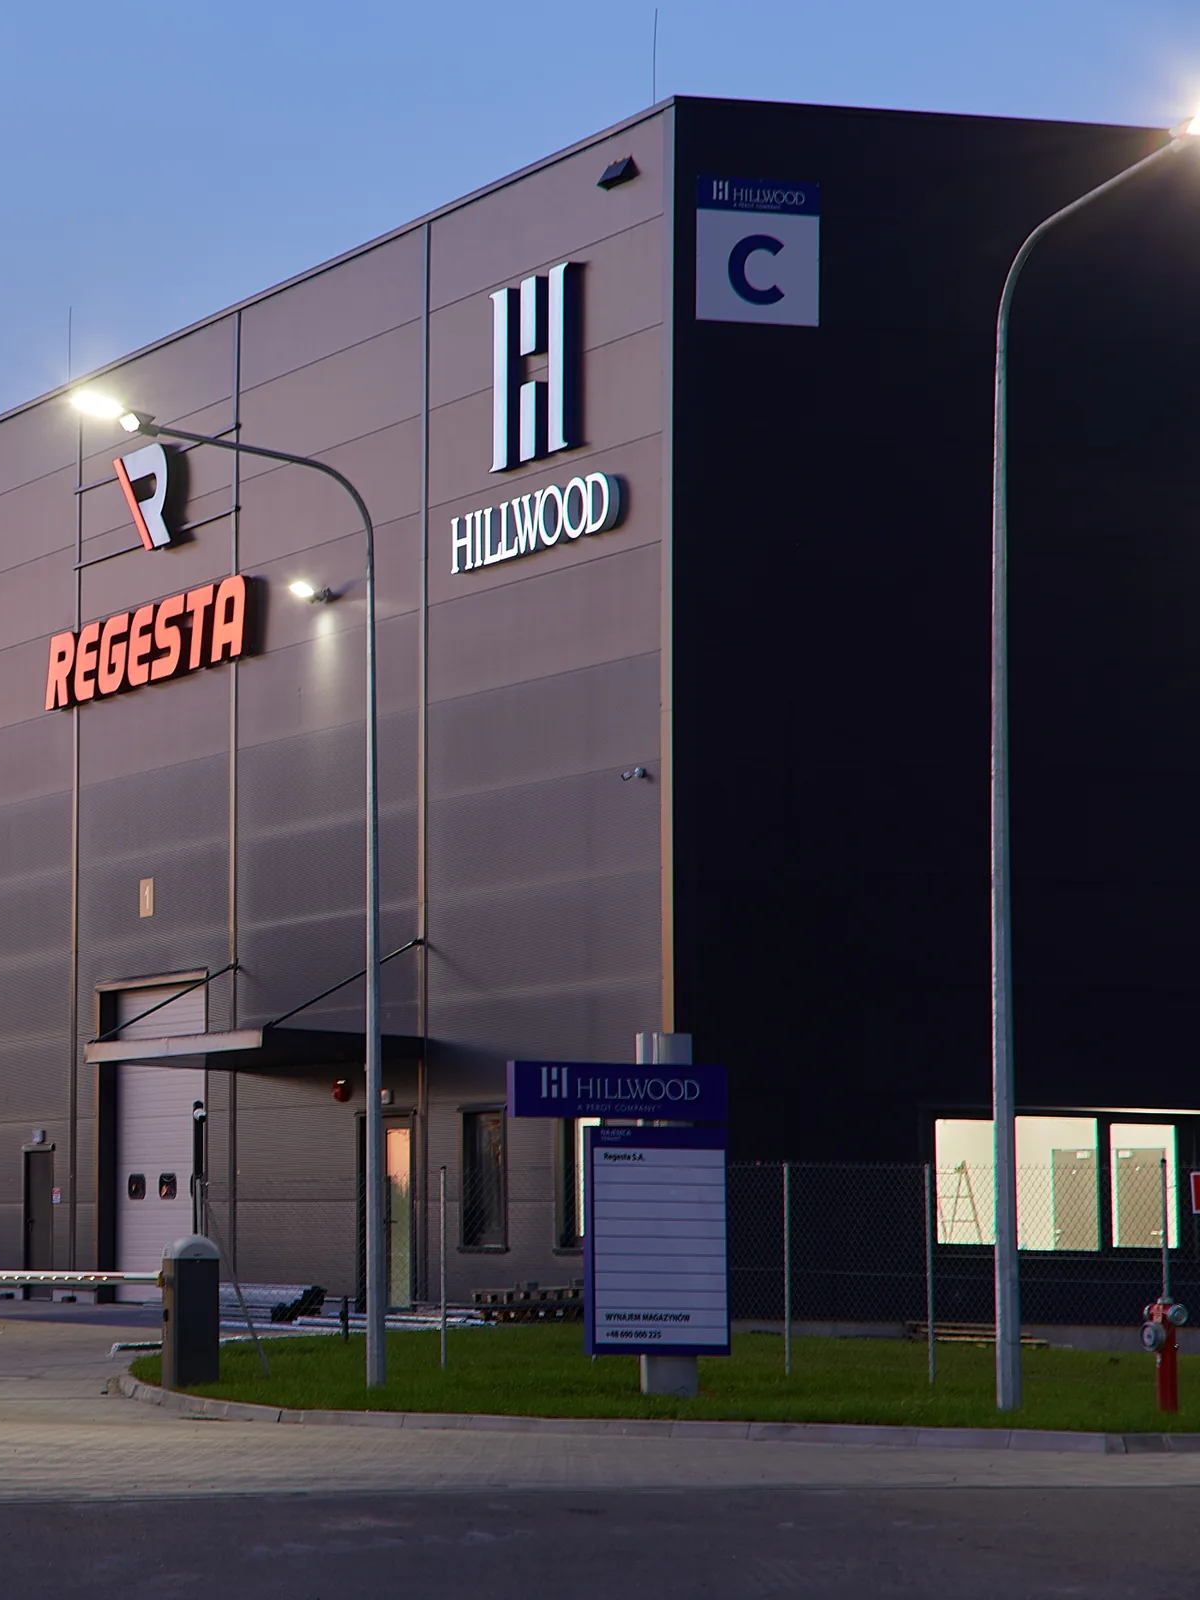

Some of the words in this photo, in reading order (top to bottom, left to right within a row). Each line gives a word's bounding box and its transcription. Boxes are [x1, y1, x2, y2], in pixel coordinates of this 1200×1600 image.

[732, 187, 806, 206] HILLWOOD
[728, 234, 785, 305] C
[112, 442, 172, 551] R
[450, 471, 617, 575] HILLWOOD
[45, 574, 247, 711] REGESTA
[144, 885, 150, 911] 1
[577, 1077, 700, 1101] HILLWOOD
[586, 1103, 611, 1112] PEROT
[604, 1152, 631, 1162] Regesta
[605, 1313, 641, 1321] WYNAJEM
[642, 1312, 691, 1322] MAGAZYNÓW
